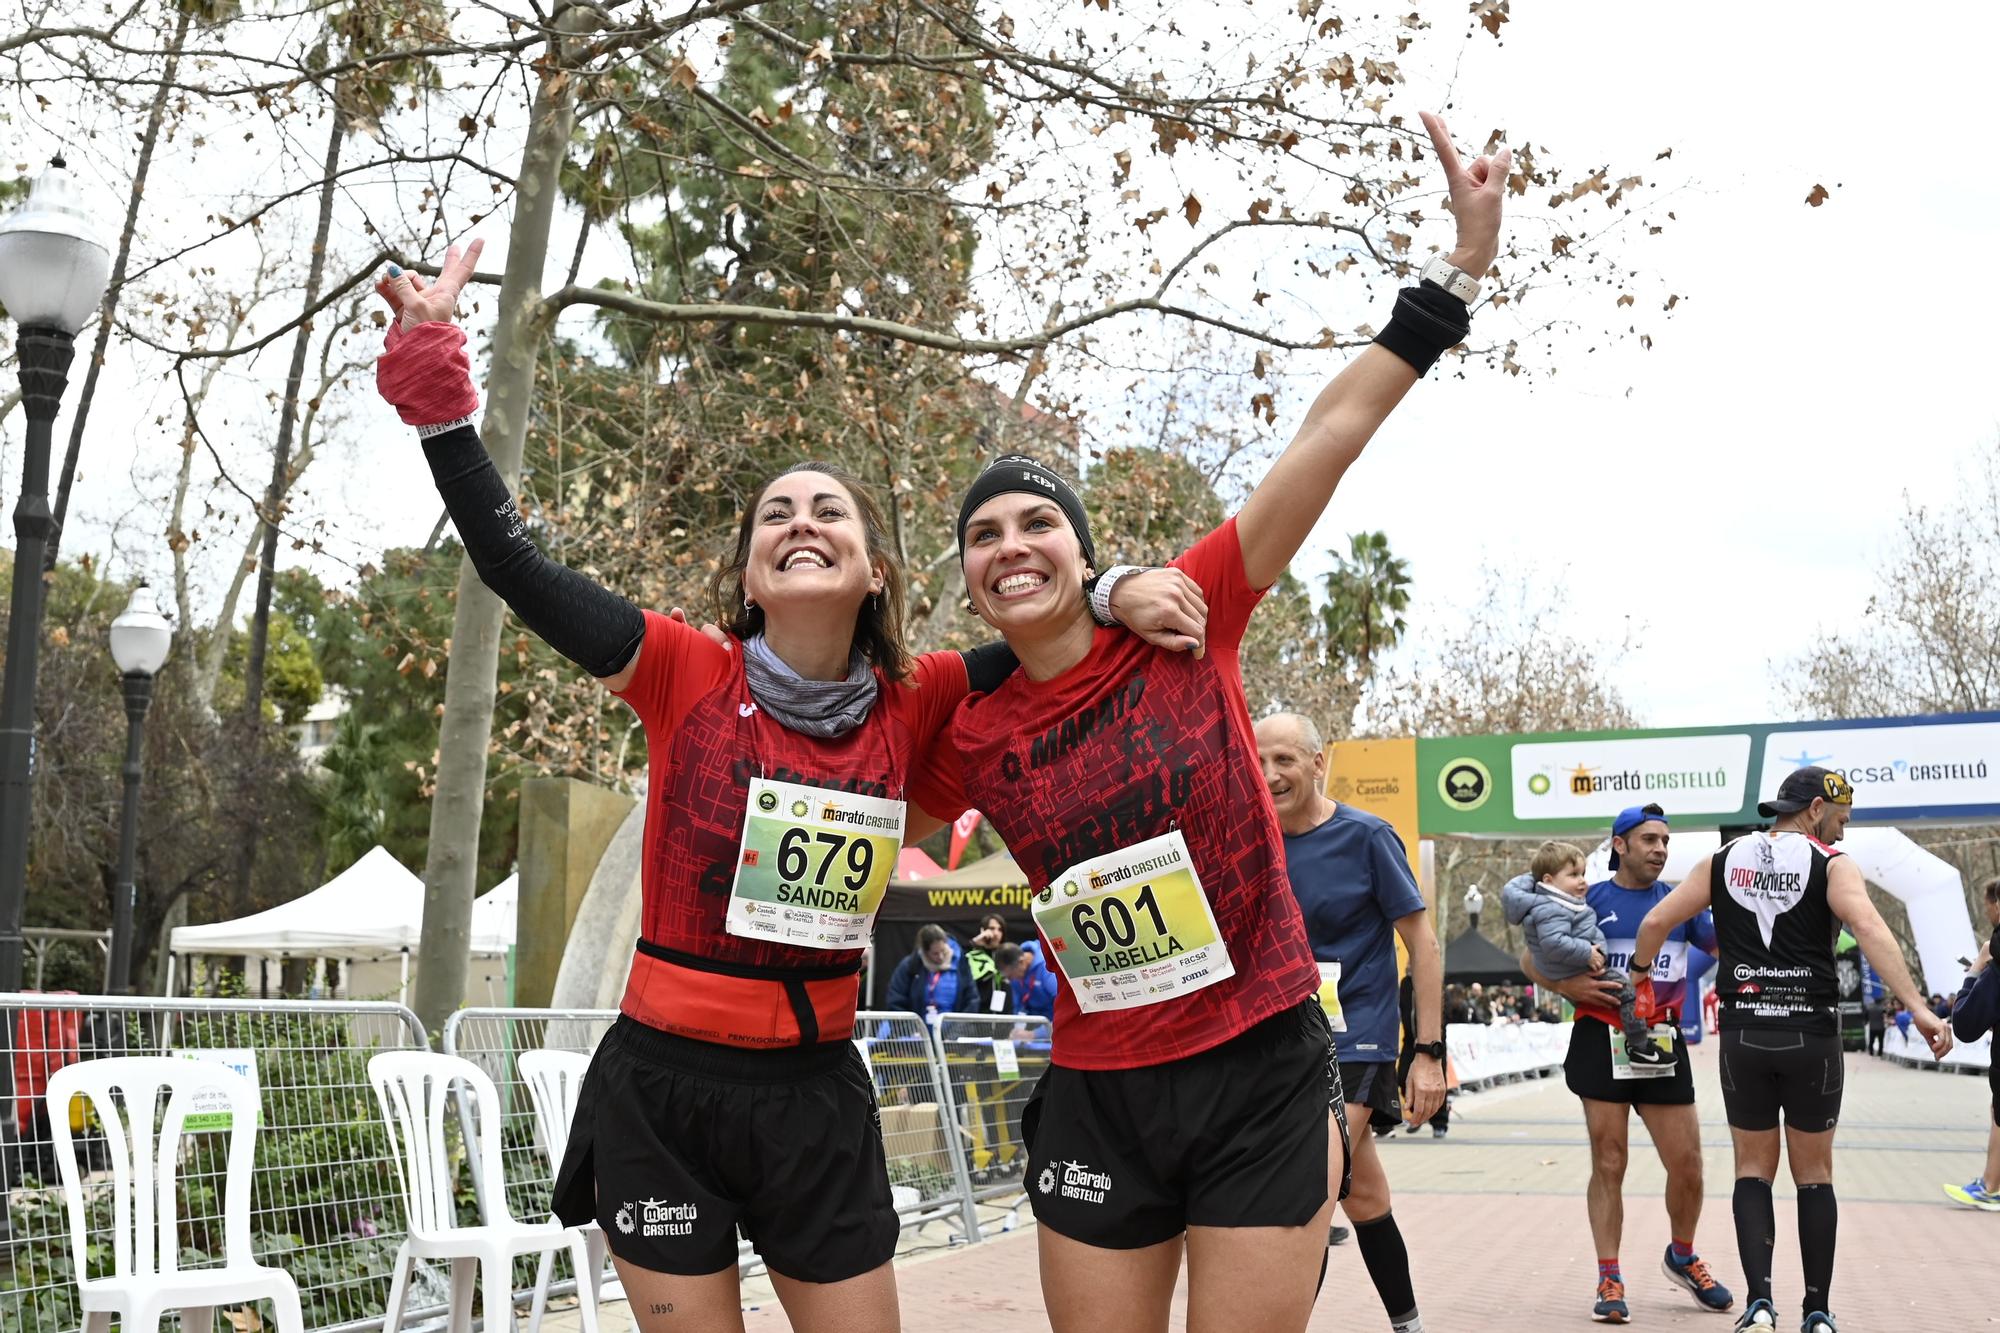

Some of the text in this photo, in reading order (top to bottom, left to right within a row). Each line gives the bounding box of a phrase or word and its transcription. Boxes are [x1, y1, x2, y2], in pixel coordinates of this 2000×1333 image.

[1573, 767, 1726, 793] marató CASTELLÓ
[1910, 760, 1988, 781] CASTELLÓ
[822, 807, 900, 830] marató CASTELLÓ
[776, 827, 873, 891] 679
[1090, 848, 1181, 888] marató CASTELLÓ
[776, 883, 858, 912] SANDRA
[928, 883, 1032, 910] www.chip
[1071, 884, 1168, 952] 601
[1089, 935, 1184, 973] P.ABELLA
[1064, 1167, 1112, 1191] marató
[624, 1201, 634, 1210] bp
[1061, 1184, 1105, 1204] CASTELLÓ
[643, 1203, 697, 1223] marató
[643, 1222, 693, 1236] CASTELLÓ
[650, 1303, 674, 1314] 1990
